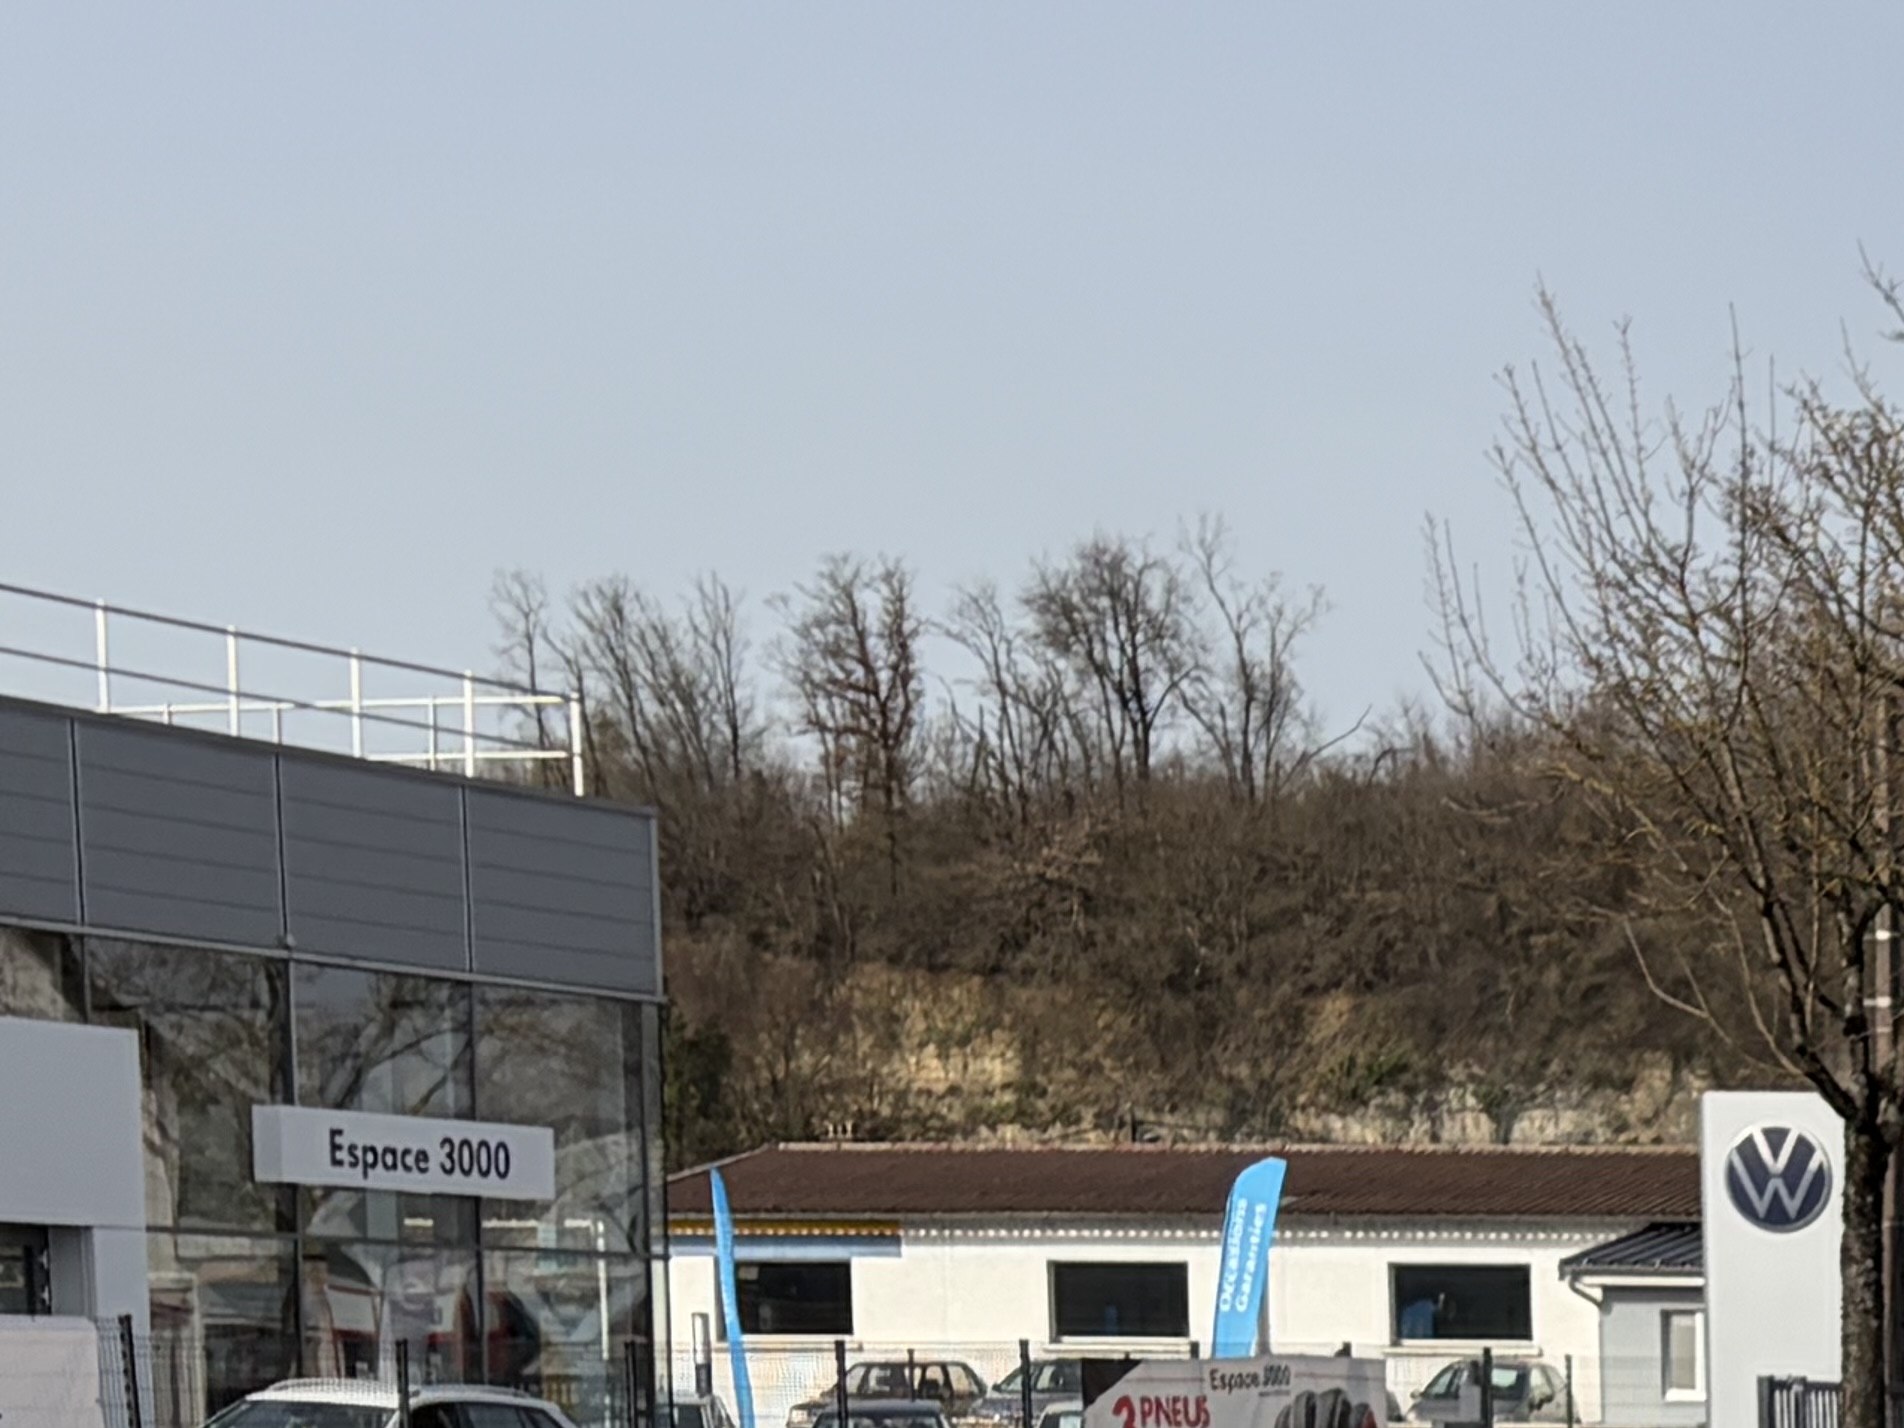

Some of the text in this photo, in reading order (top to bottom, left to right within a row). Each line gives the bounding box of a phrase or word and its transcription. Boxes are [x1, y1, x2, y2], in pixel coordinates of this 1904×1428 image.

[329, 1128, 510, 1180] Espace 3000
[1141, 1395, 1211, 1428] PNEUS
